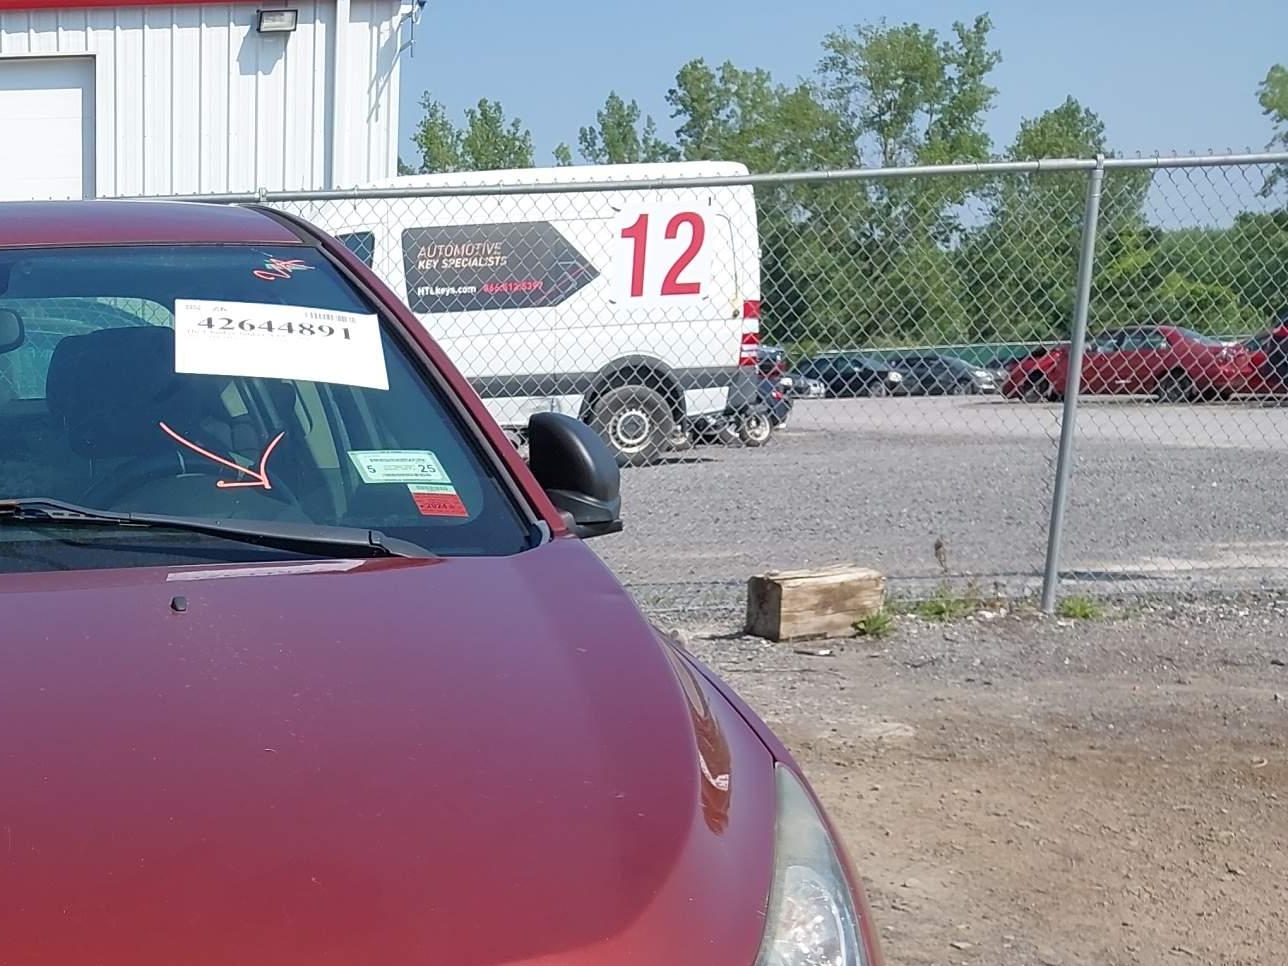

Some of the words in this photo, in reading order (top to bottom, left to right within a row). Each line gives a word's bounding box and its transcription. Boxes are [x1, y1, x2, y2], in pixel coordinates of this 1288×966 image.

[418, 242, 503, 258] AUTOMOTIVE
[620, 211, 705, 297] 12
[418, 259, 439, 270] KEY
[441, 256, 507, 269] SPECIALISTS
[197, 316, 352, 340] 42644891
[367, 465, 376, 473] 5
[418, 464, 436, 473] 25
